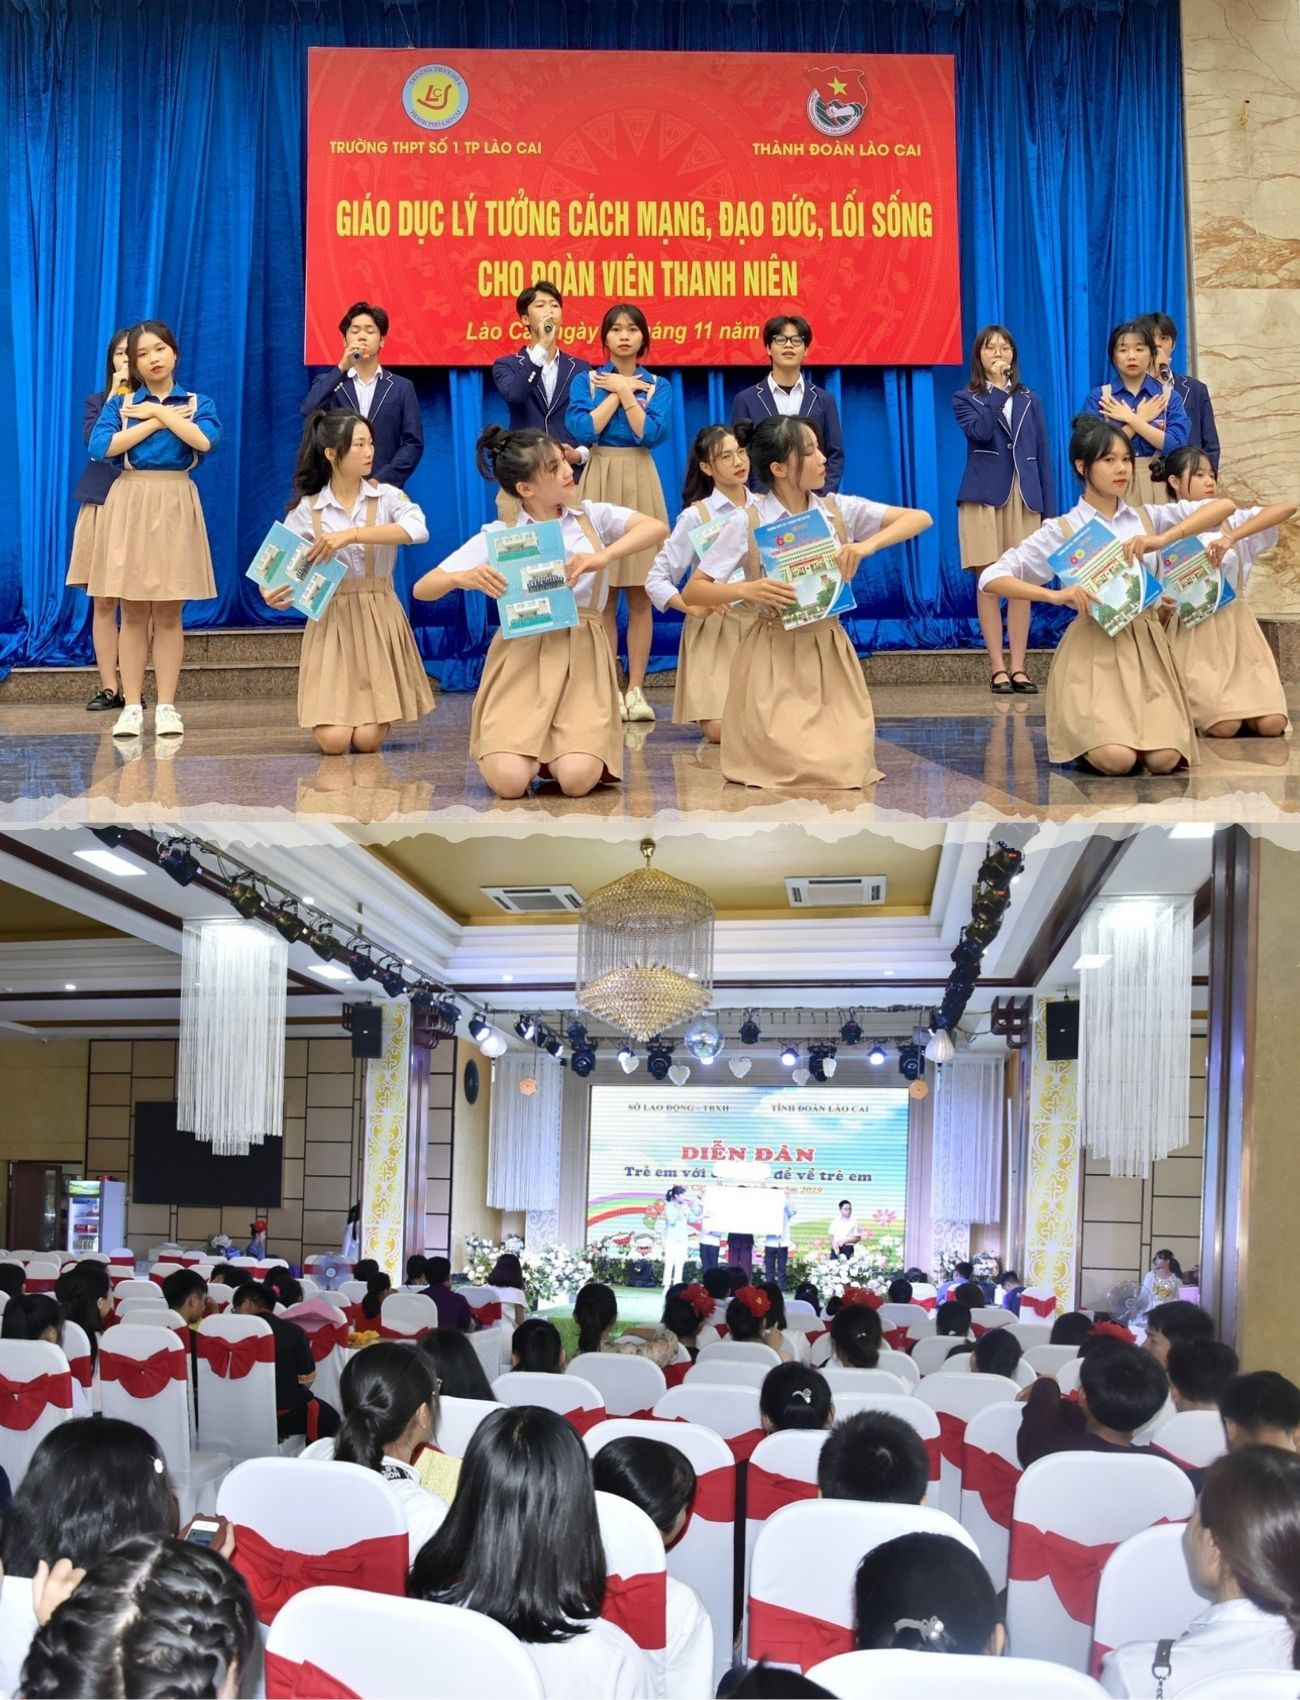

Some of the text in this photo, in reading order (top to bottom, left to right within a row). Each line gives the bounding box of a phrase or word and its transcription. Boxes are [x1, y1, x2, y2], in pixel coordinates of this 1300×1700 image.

[330, 137, 542, 154] TRƯỜNG THPT SỐ 1 TP LÀO CAI
[753, 140, 921, 156] THÀNH ĐOÀN LÀO CAI
[336, 188, 933, 245] GIÁO DỤC LÝ TƯỞNG CÁCH MẠNG, ĐẠO ĐỨC, LỐI SỐNG
[478, 260, 524, 297] CHO
[602, 253, 654, 297] VIÊN
[661, 260, 736, 297] THANH
[743, 253, 798, 297] NIÊN
[466, 321, 502, 340] Lào
[509, 322, 532, 340] Ca
[650, 321, 687, 344] áng
[694, 321, 713, 339] 11
[720, 321, 760, 339] năm
[628, 1102, 641, 1112] SỞ
[643, 1104, 663, 1112] LAO
[666, 1104, 695, 1113] ĐỘNG
[798, 1103, 825, 1112] ĐOÀN
[828, 1103, 849, 1113] LÀO
[851, 1105, 869, 1113] CAI
[681, 1139, 815, 1162] DIỄN ĐÀN
[624, 1165, 651, 1177] Trẻ
[682, 1168, 706, 1178] với
[773, 1167, 872, 1182] đề về trẻ em
